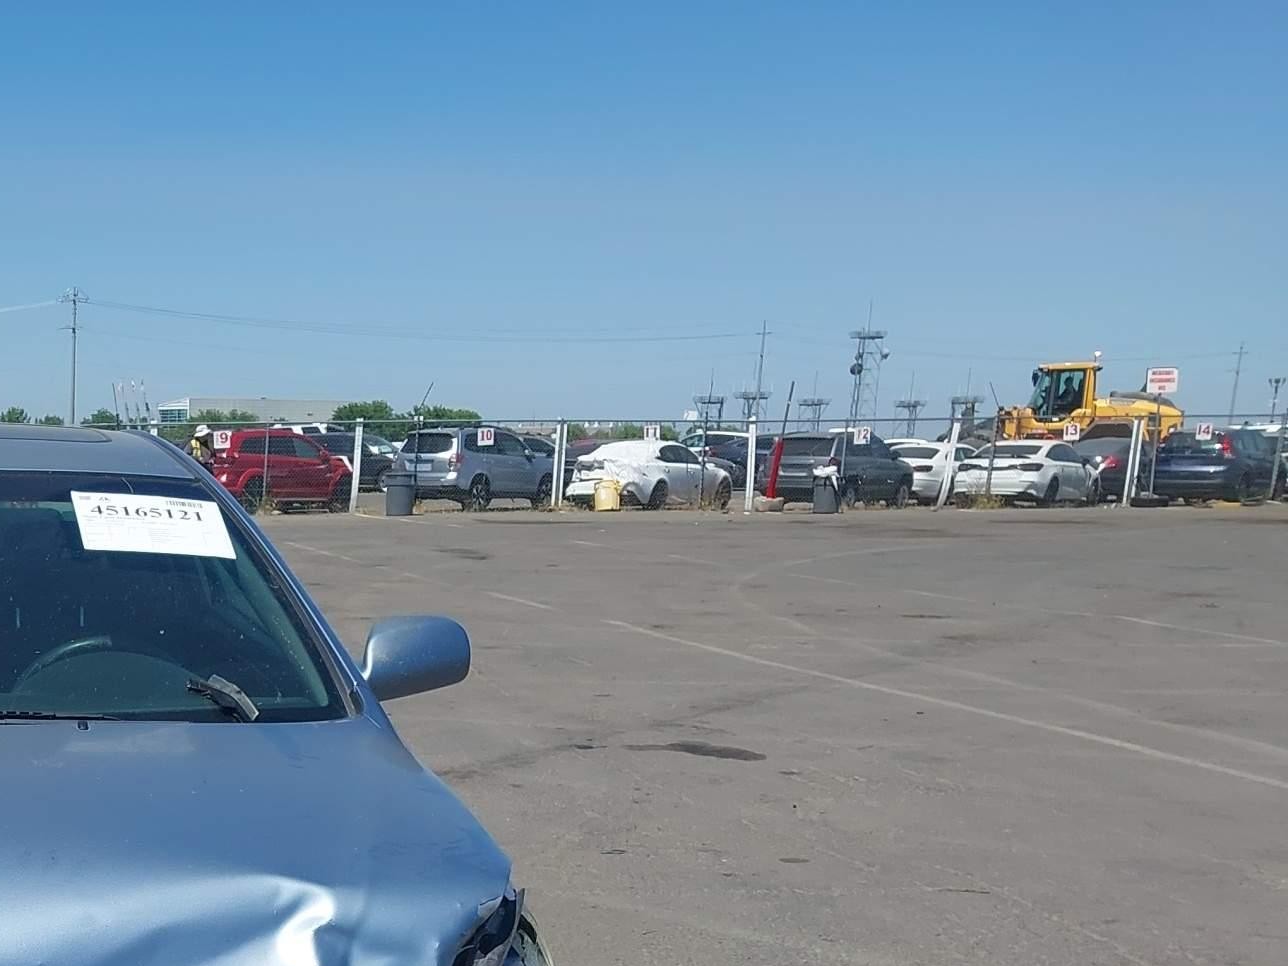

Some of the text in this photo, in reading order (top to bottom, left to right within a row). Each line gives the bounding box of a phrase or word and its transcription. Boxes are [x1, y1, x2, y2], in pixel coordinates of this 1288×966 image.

[480, 429, 493, 442] 10
[856, 428, 869, 440] 12
[1065, 424, 1079, 436] 13
[1197, 424, 1211, 436] 14
[219, 431, 229, 444] 9
[90, 504, 205, 522] 45165121
